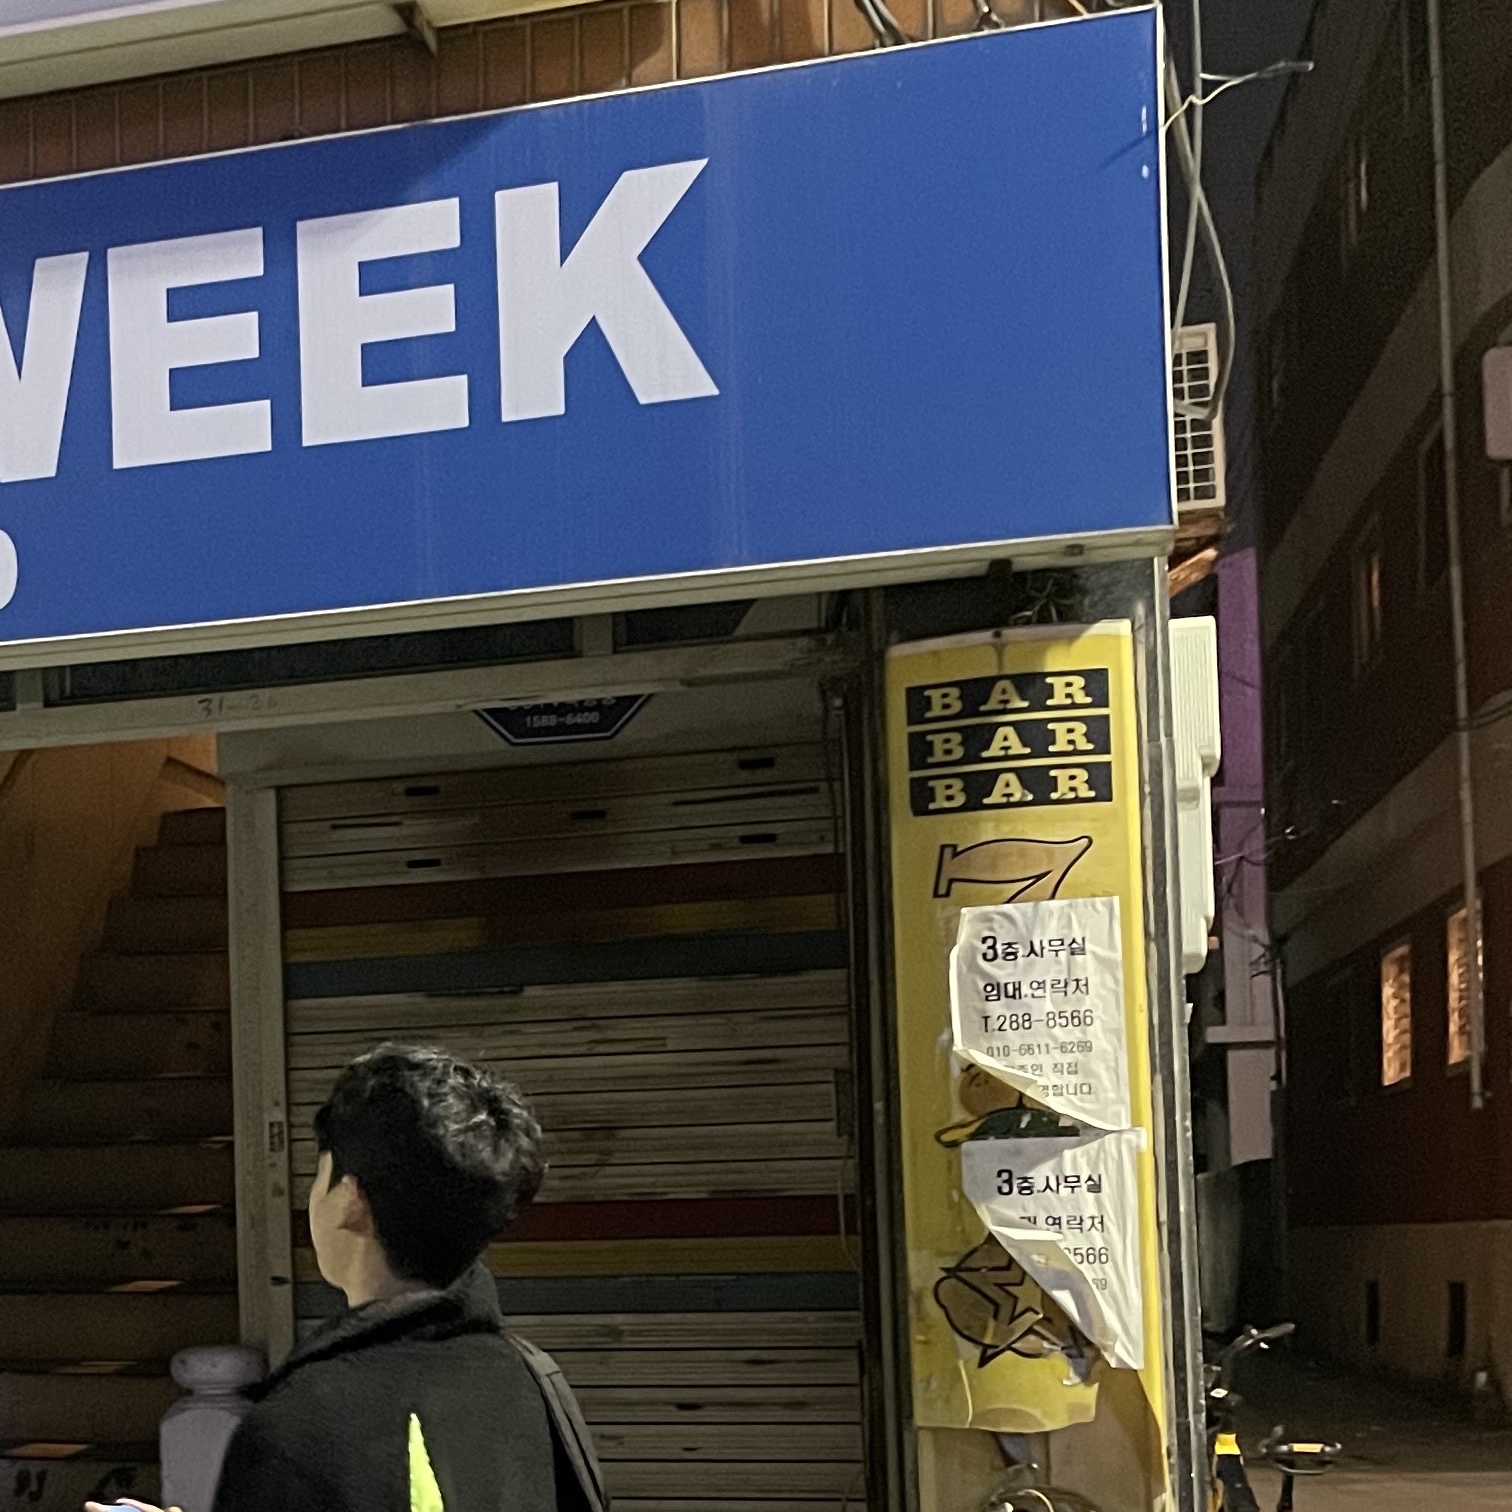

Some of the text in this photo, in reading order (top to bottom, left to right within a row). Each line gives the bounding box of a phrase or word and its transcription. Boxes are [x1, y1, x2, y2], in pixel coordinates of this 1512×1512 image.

[923, 675, 1093, 718] BAR
[926, 721, 1094, 763] BAR
[927, 767, 1096, 810] BAR
